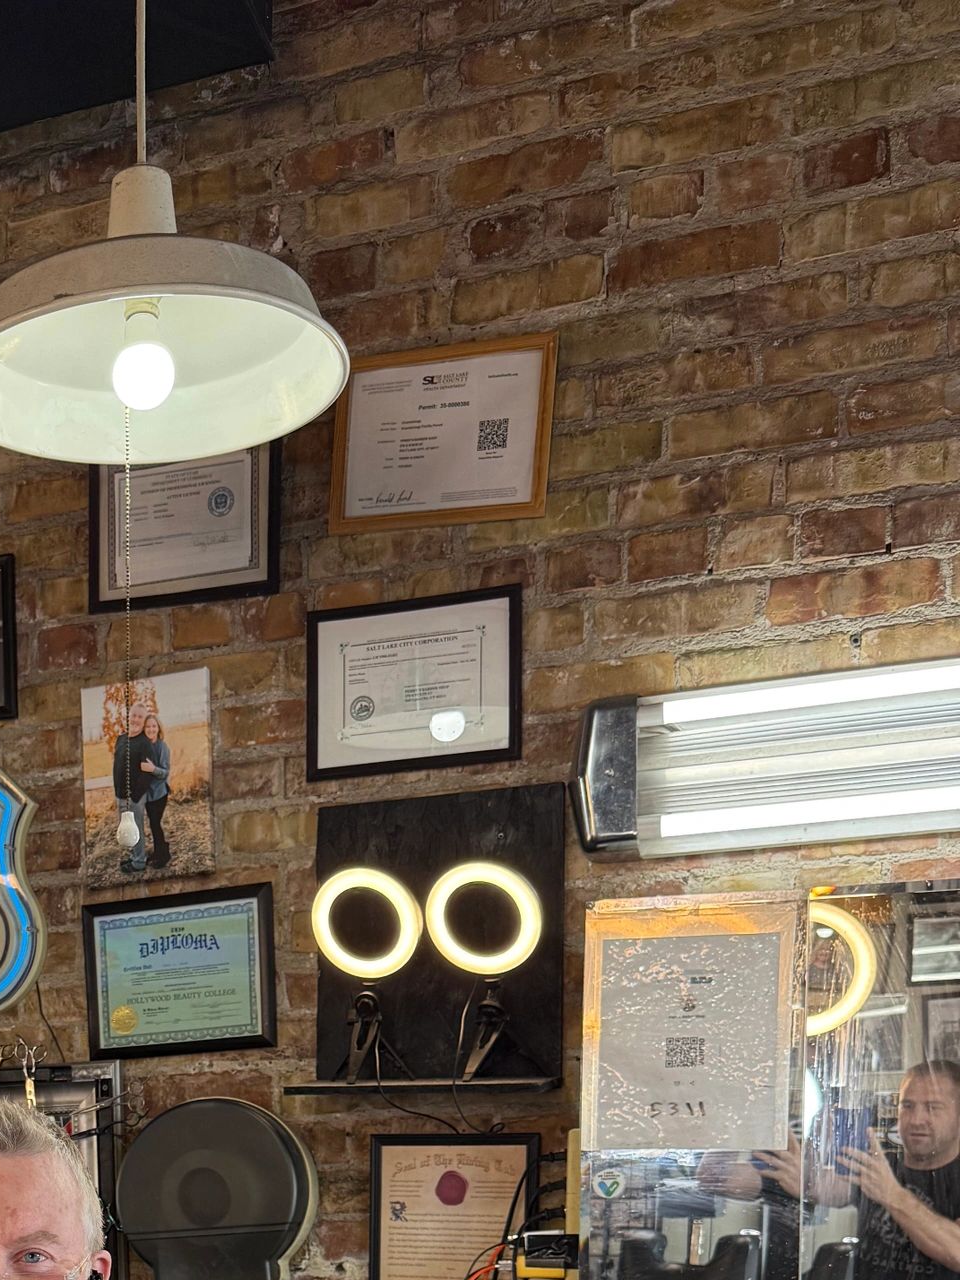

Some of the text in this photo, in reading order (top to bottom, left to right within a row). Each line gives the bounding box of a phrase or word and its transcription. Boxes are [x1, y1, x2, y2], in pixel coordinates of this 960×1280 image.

[382, 642, 398, 650] LAKE
[399, 640, 414, 648] CITY
[414, 635, 459, 645] CORPORATION
[139, 933, 220, 958] DIPLOMA
[126, 988, 237, 1005] HOLLYWOOD BEAUTY COLLEGE
